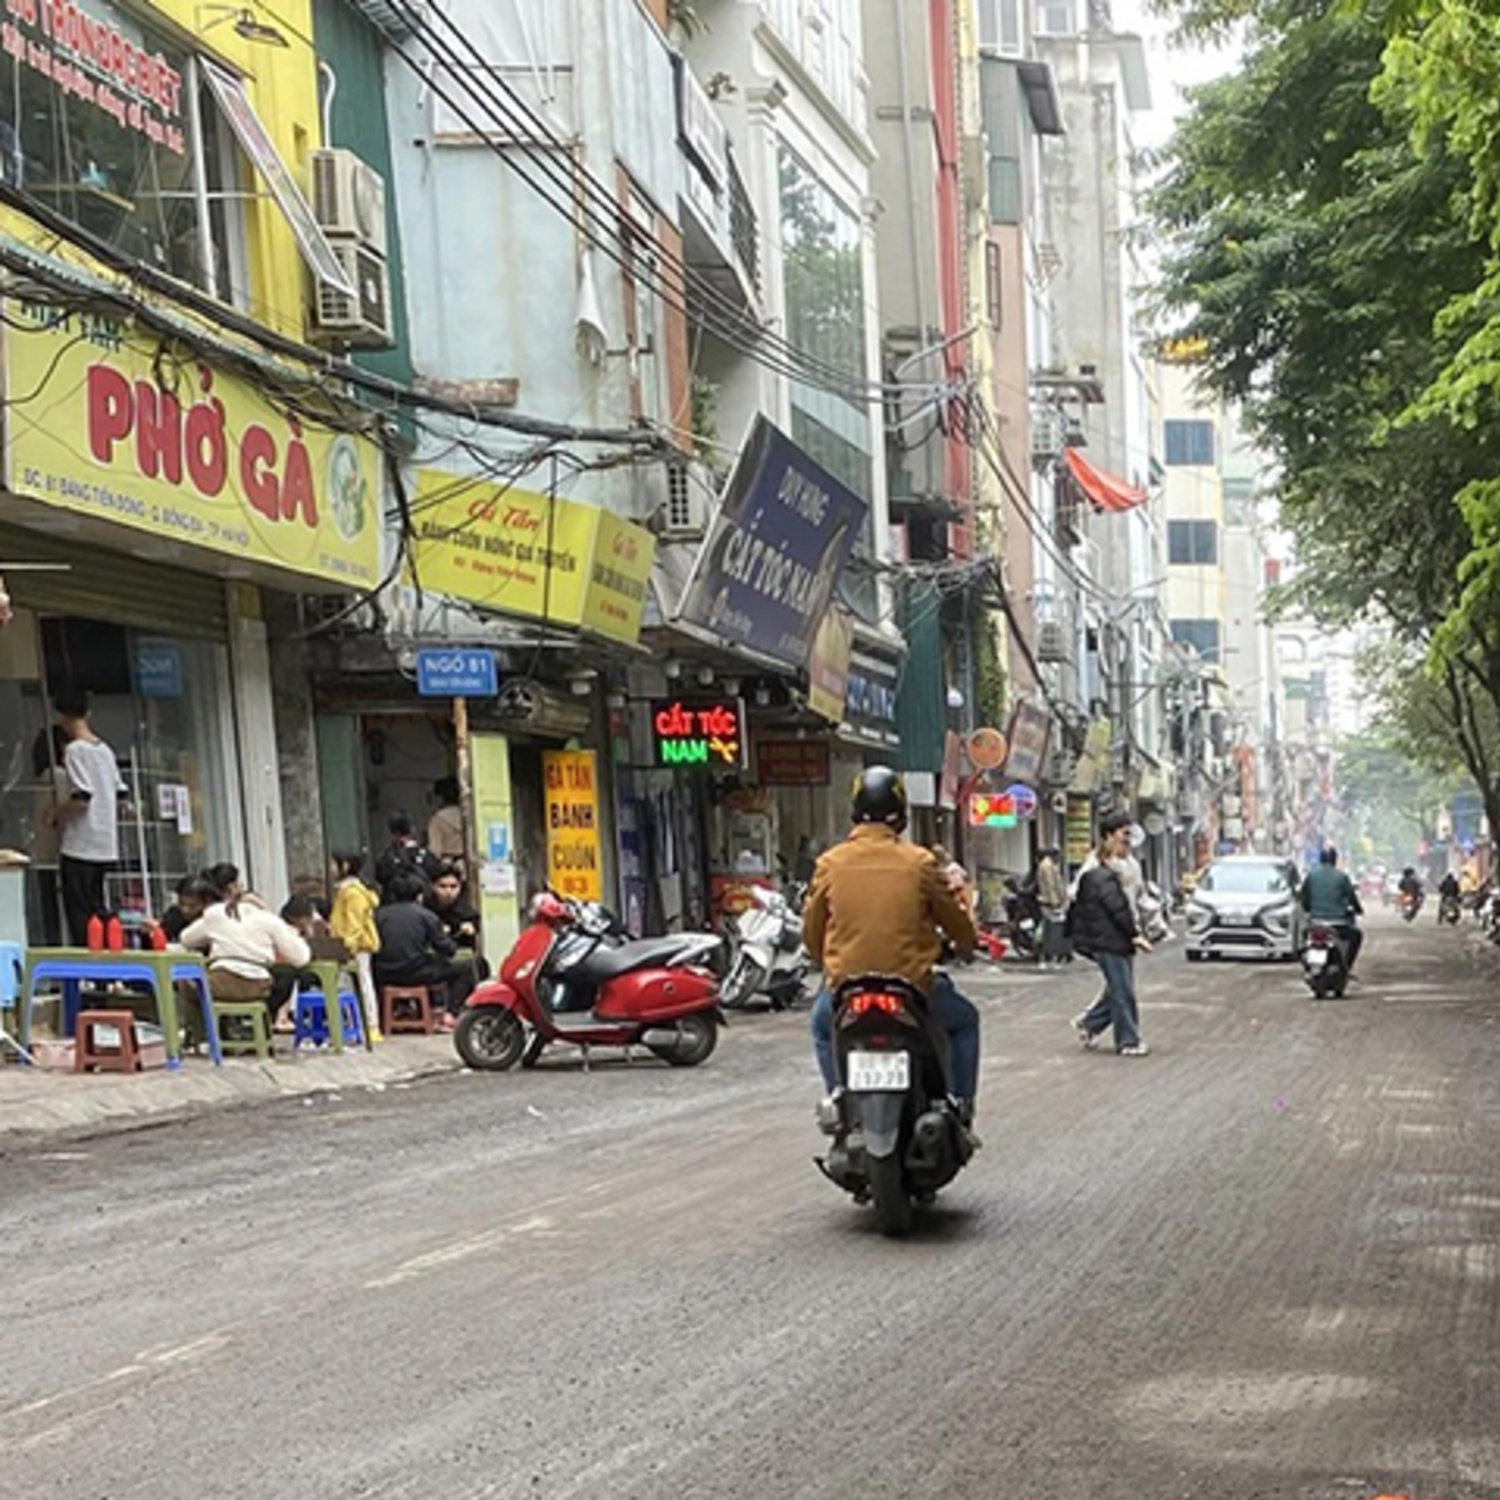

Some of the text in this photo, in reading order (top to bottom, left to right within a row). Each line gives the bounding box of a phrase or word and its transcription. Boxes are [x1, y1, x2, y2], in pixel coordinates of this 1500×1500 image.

[87, 364, 319, 529] PHỞ GÀ
[469, 657, 487, 673] 81
[656, 702, 736, 735] CẮT TÓC
[662, 738, 708, 763] NAM
